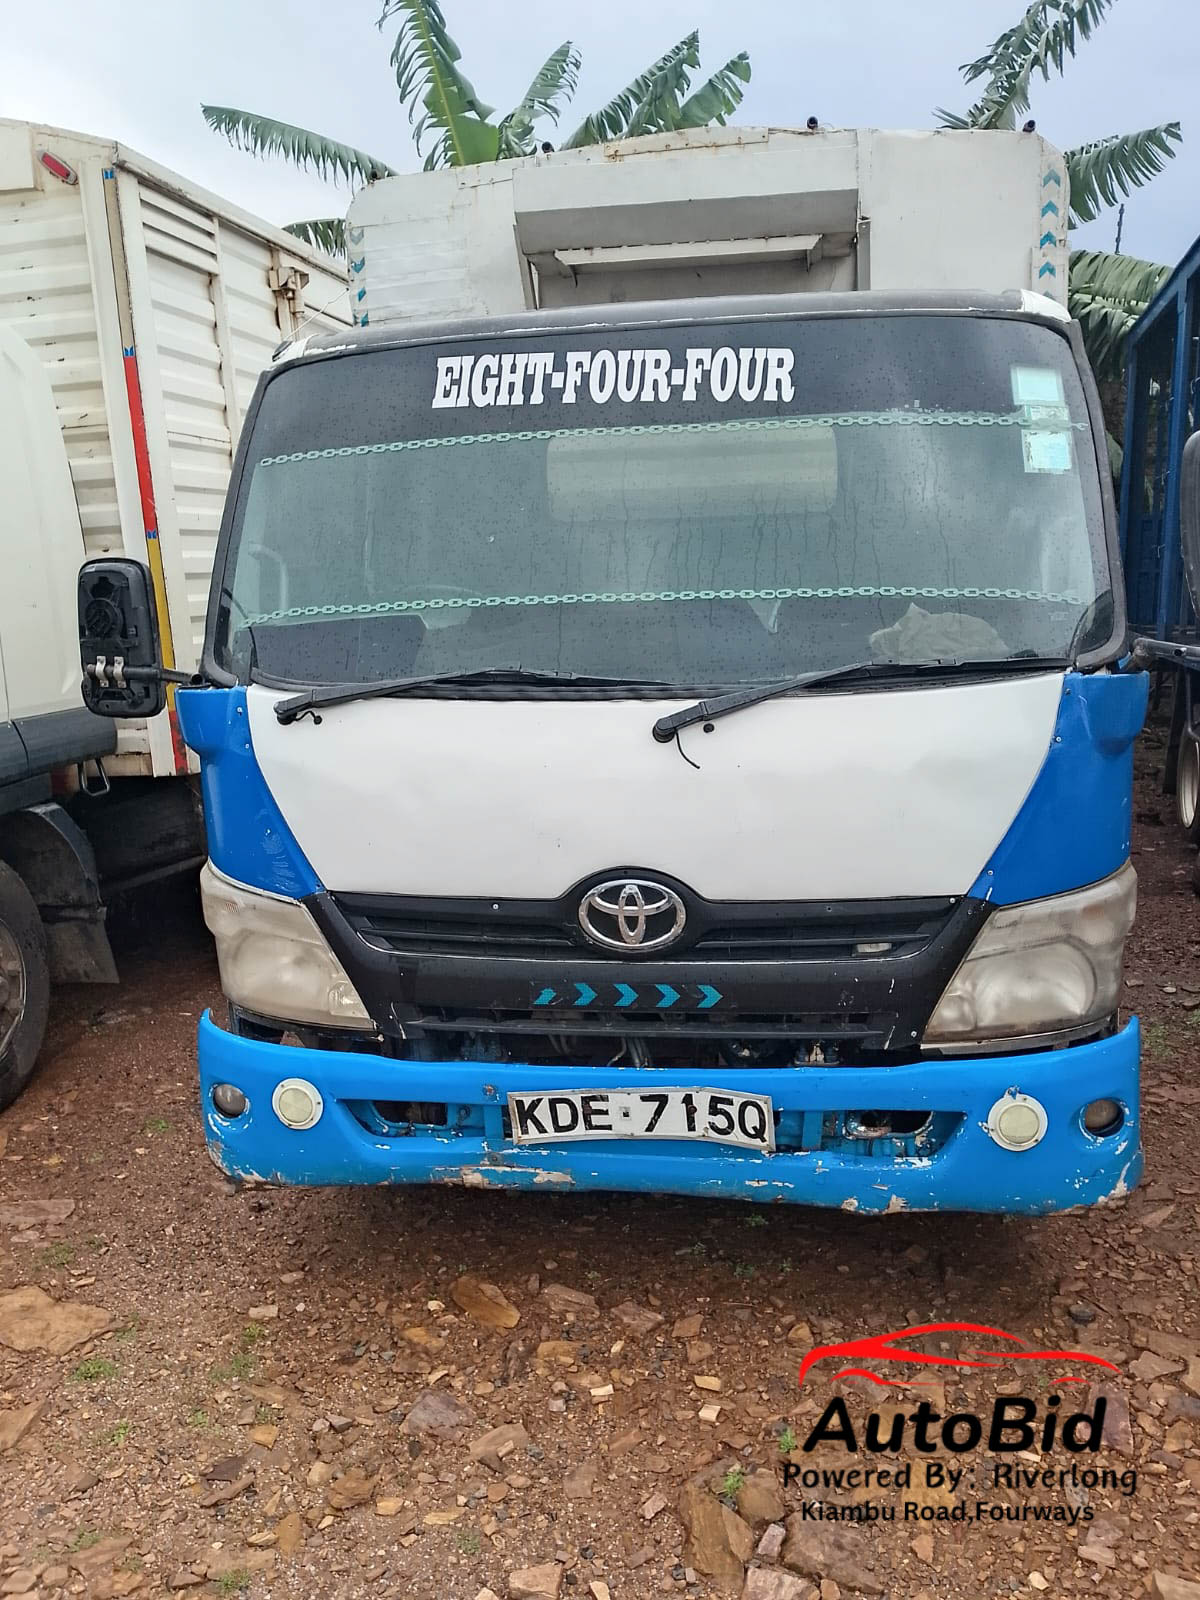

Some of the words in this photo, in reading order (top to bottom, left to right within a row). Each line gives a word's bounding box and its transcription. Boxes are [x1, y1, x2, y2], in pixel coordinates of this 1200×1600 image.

[431, 346, 796, 410] EIGHT-FOUR-FOUR
[515, 1094, 613, 1135] KDE
[639, 1093, 767, 1143] 715Q
